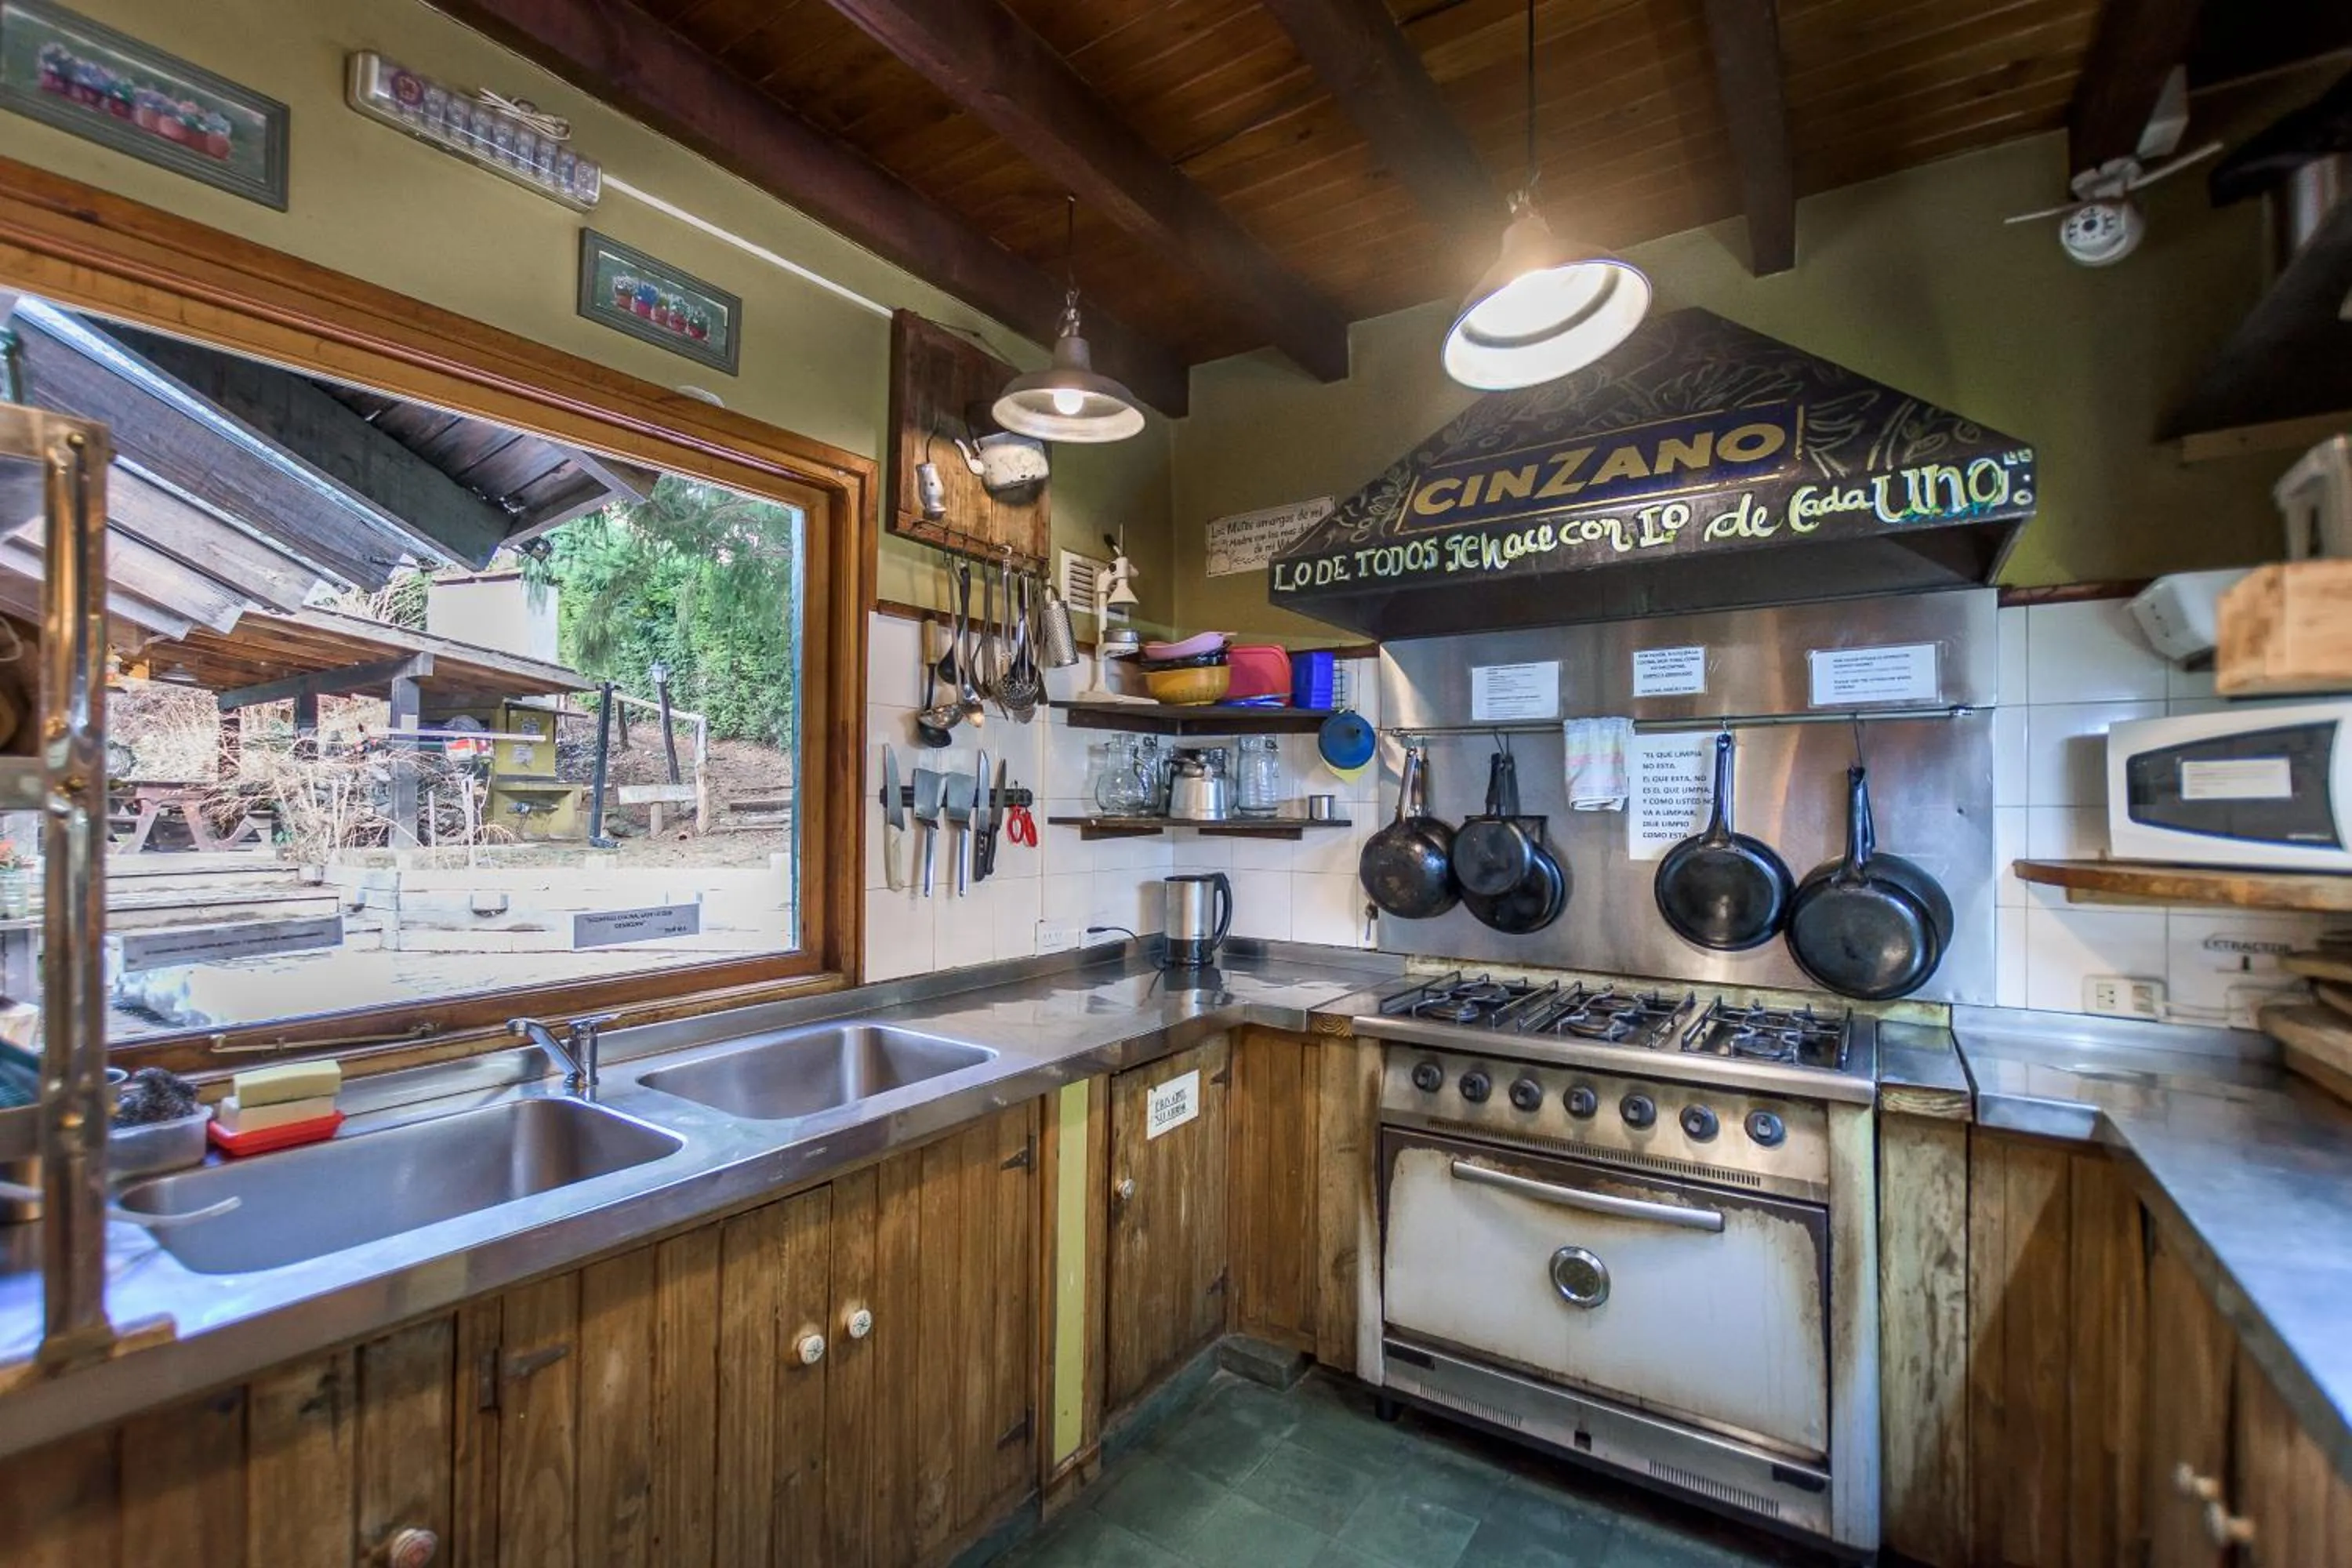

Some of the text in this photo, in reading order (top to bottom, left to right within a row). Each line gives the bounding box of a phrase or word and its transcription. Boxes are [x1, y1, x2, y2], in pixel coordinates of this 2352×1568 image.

[1414, 423, 1785, 515] CINZANO
[1274, 559, 1312, 590] LO
[1315, 555, 1351, 586] DE
[1355, 536, 1439, 578] TODOS
[1559, 518, 1633, 552] con
[1704, 493, 1784, 543] de
